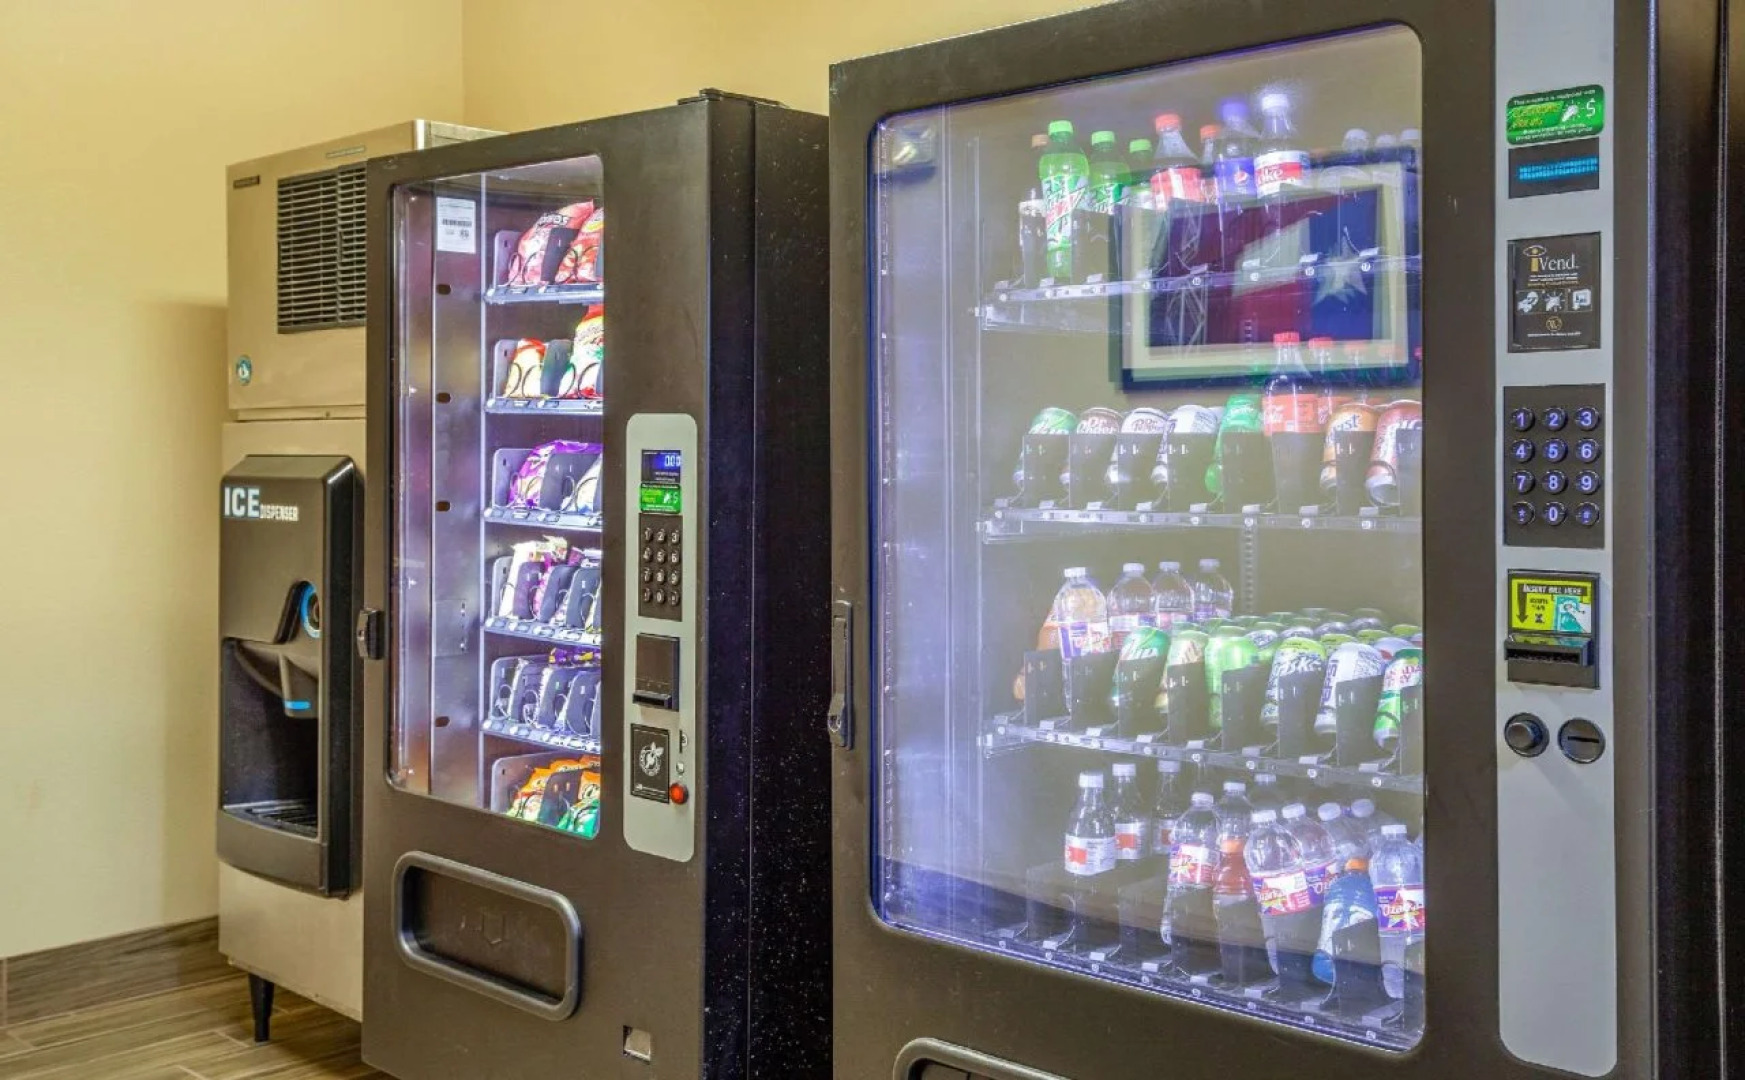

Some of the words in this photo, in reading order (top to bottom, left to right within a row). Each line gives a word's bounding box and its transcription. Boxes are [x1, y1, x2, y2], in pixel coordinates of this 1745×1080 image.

[1517, 413, 1525, 427] 1
[1550, 413, 1559, 426] 2
[1581, 412, 1592, 426] 3
[1516, 444, 1525, 458] 4
[1549, 444, 1558, 458] 5
[1581, 443, 1592, 458] 6
[1517, 476, 1526, 490] 7
[1549, 475, 1558, 490] 8
[1581, 475, 1592, 490] 9
[224, 487, 260, 518] ICE
[1549, 507, 1558, 521] 0
